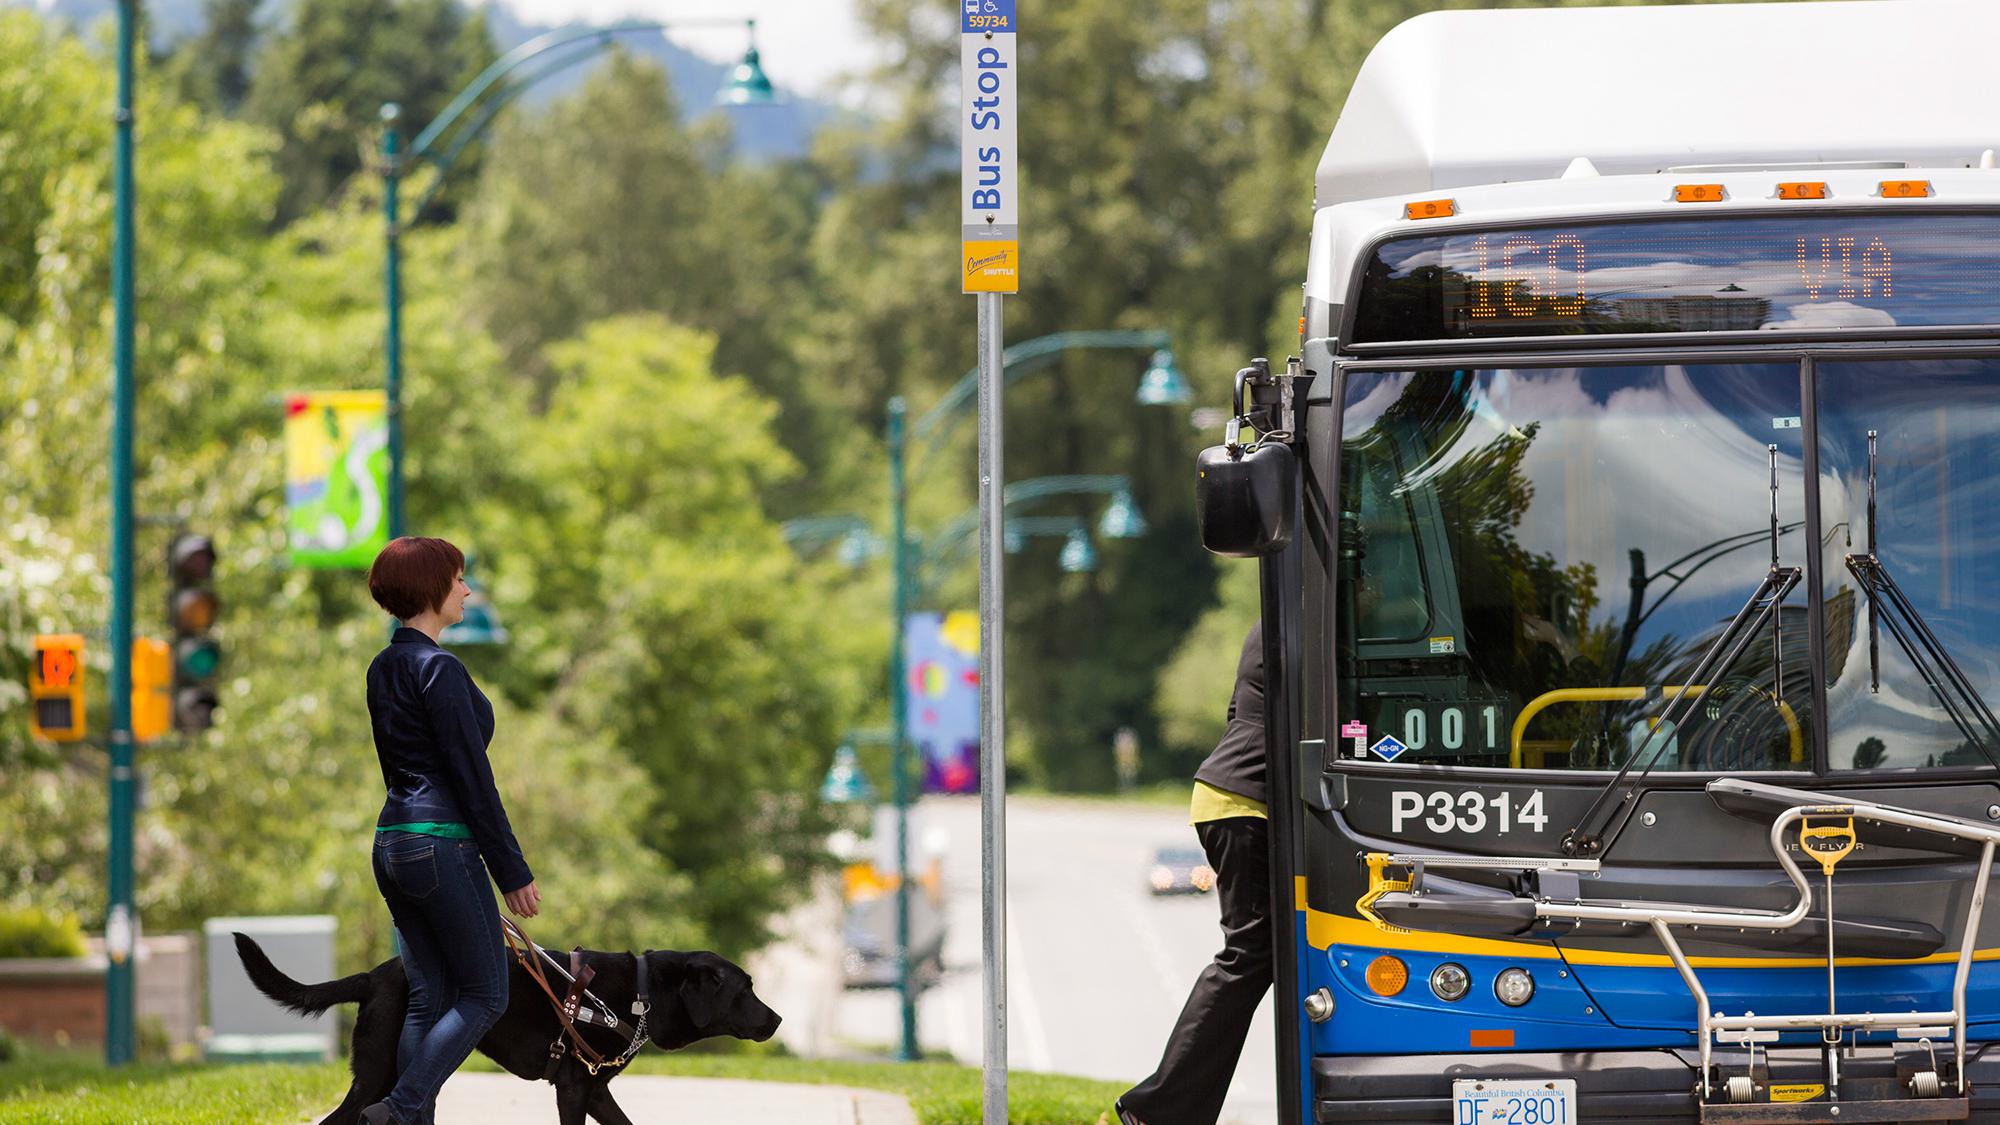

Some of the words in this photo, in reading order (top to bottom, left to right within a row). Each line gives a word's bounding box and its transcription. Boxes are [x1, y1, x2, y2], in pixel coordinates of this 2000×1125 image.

[969, 15, 1008, 27] 59734
[971, 47, 1008, 130] Stop
[972, 146, 1001, 209] Bus
[967, 250, 1008, 272] Community
[984, 268, 1014, 276] SHUTTLE
[1471, 234, 1585, 317] 160
[1797, 236, 1891, 299] VIA
[1405, 706, 1496, 750] 001
[1391, 790, 1549, 833] P3314
[1464, 1089, 1499, 1098] Beautiful
[1501, 1088, 1525, 1098] British
[1526, 1088, 1565, 1098] Columbia
[1459, 1098, 1489, 1125] DF
[1507, 1097, 1566, 1125] 2801
